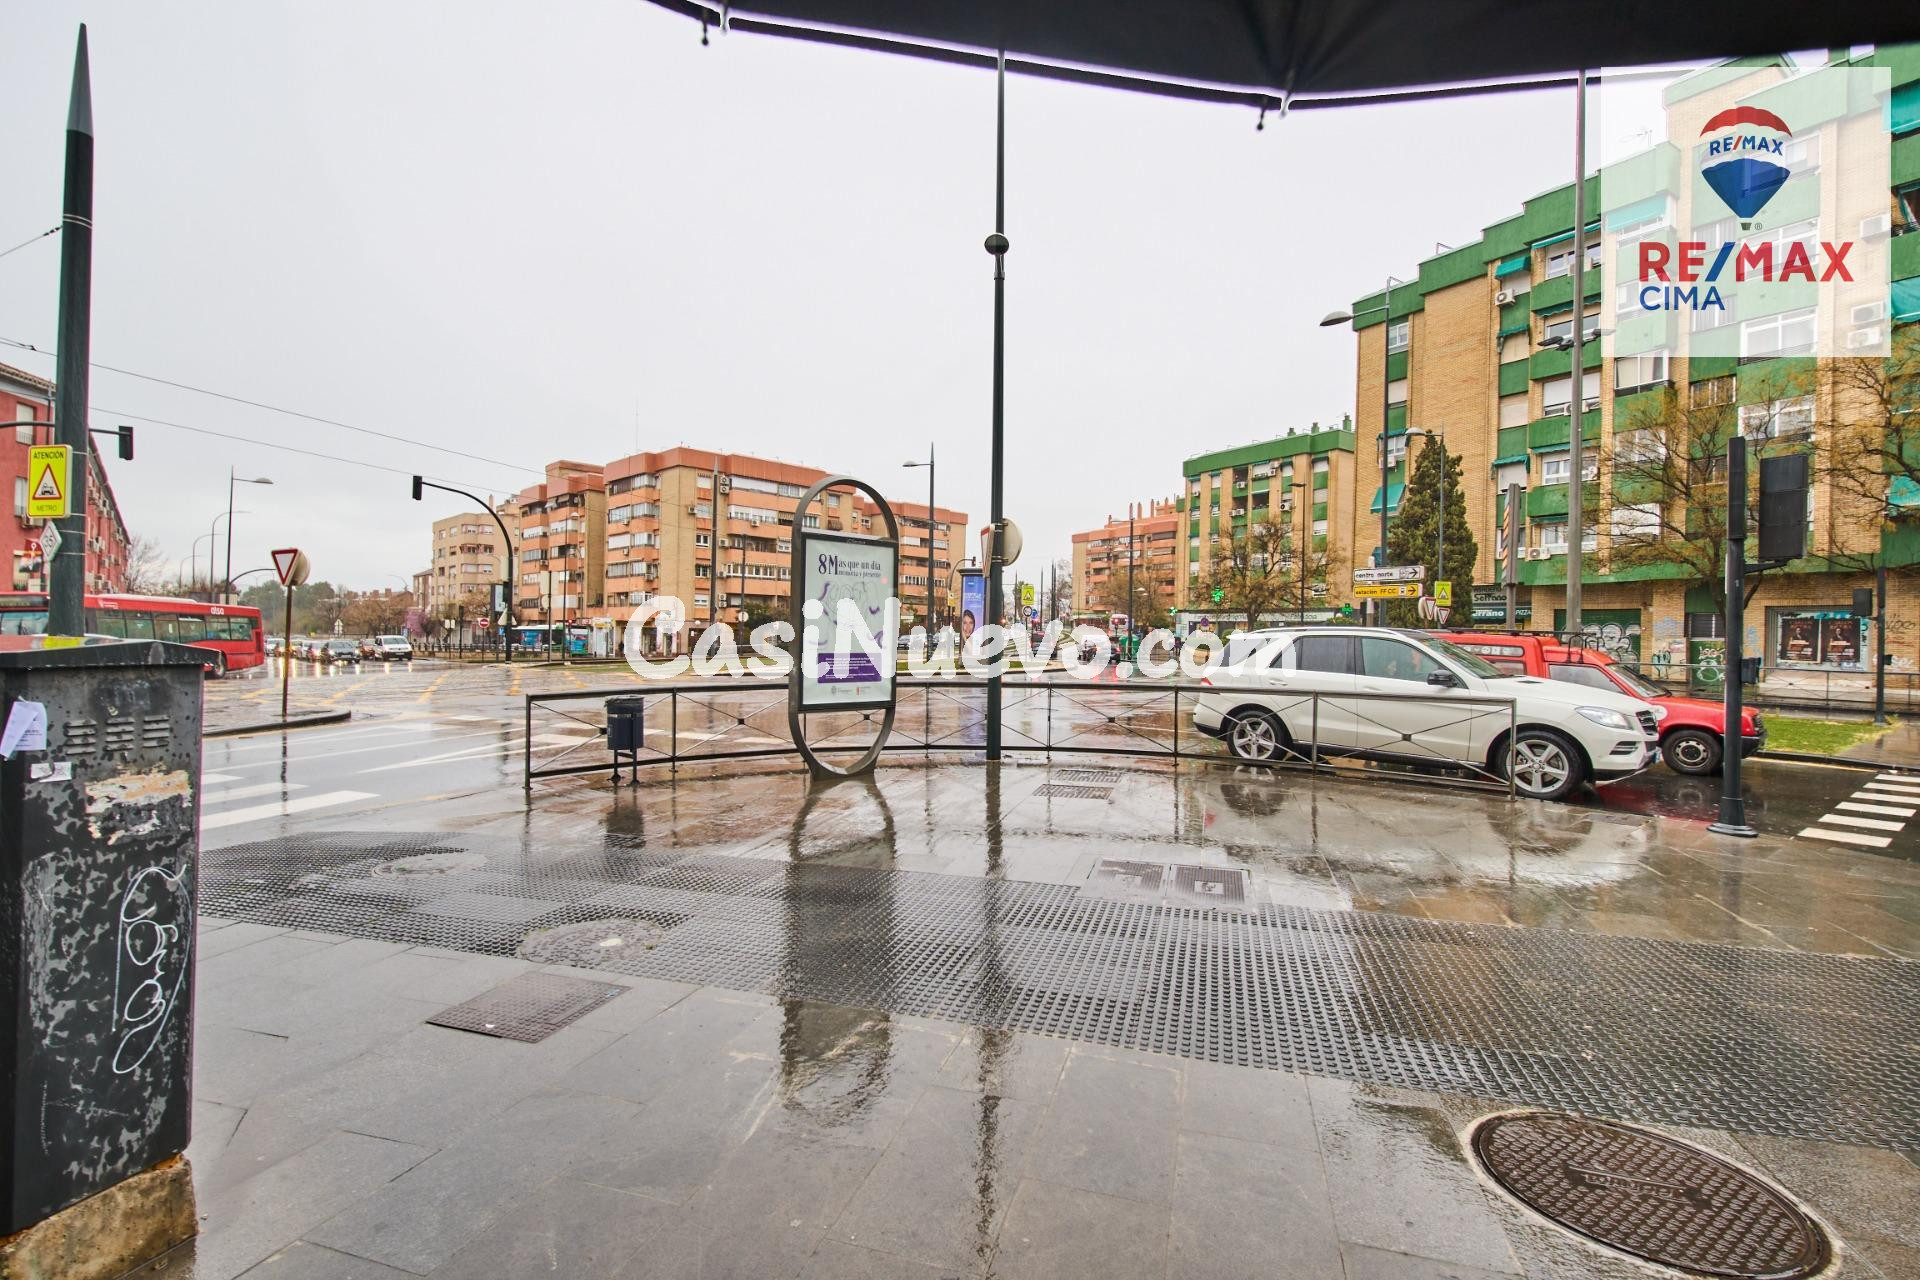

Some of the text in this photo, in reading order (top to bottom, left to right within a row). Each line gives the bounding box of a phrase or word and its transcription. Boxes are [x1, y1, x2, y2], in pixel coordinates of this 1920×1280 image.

[36, 504, 57, 512] METRO
[848, 560, 860, 571] que
[210, 606, 225, 615] alsa
